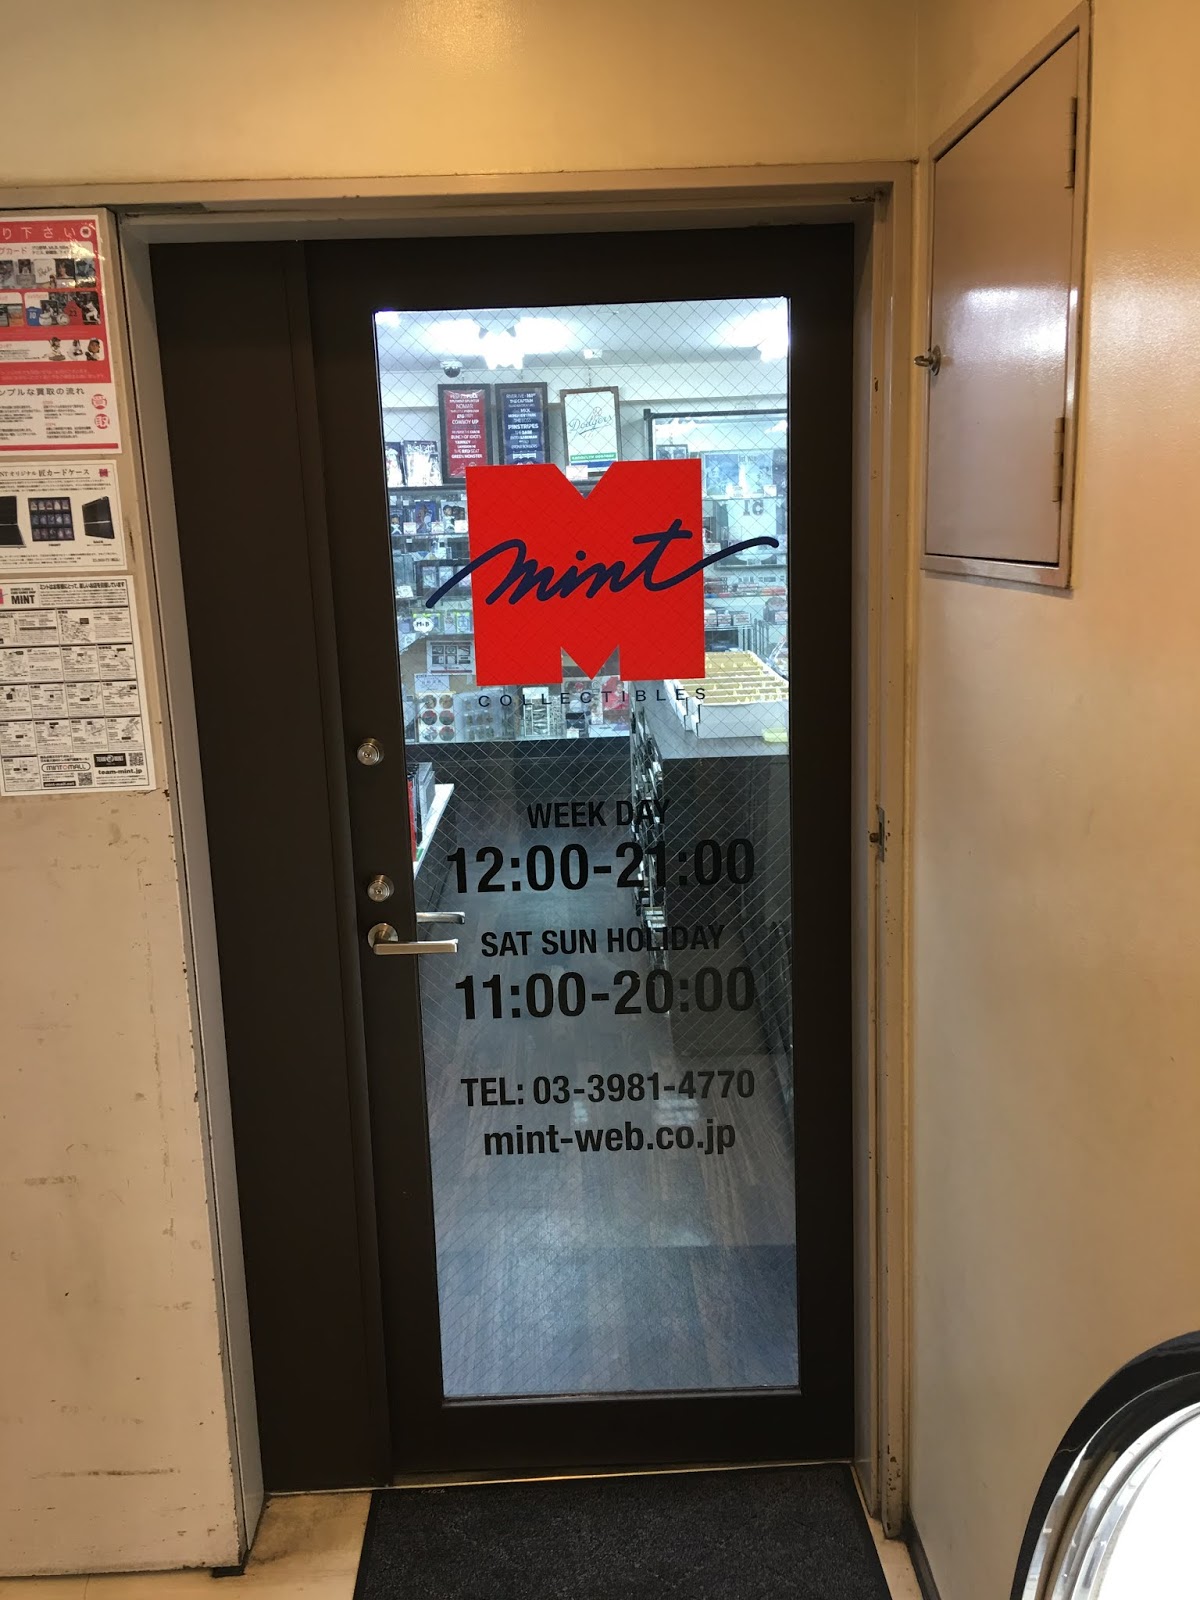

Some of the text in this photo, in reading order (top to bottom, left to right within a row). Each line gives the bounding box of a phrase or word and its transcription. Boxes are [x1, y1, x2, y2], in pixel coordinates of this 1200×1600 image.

[425, 519, 780, 609] mint
[11, 594, 35, 604] MINT
[478, 688, 706, 708] COLLECTIBLES
[527, 799, 669, 829] WEEK DAY
[447, 838, 755, 894] 12:00-21:00
[481, 924, 725, 957] SAT SUN HOLIDAY
[455, 966, 755, 1020] 11:00-20:00
[460, 1069, 755, 1107] TEL: 03-3981-4770
[483, 1119, 736, 1156] mint-web.co.jp
